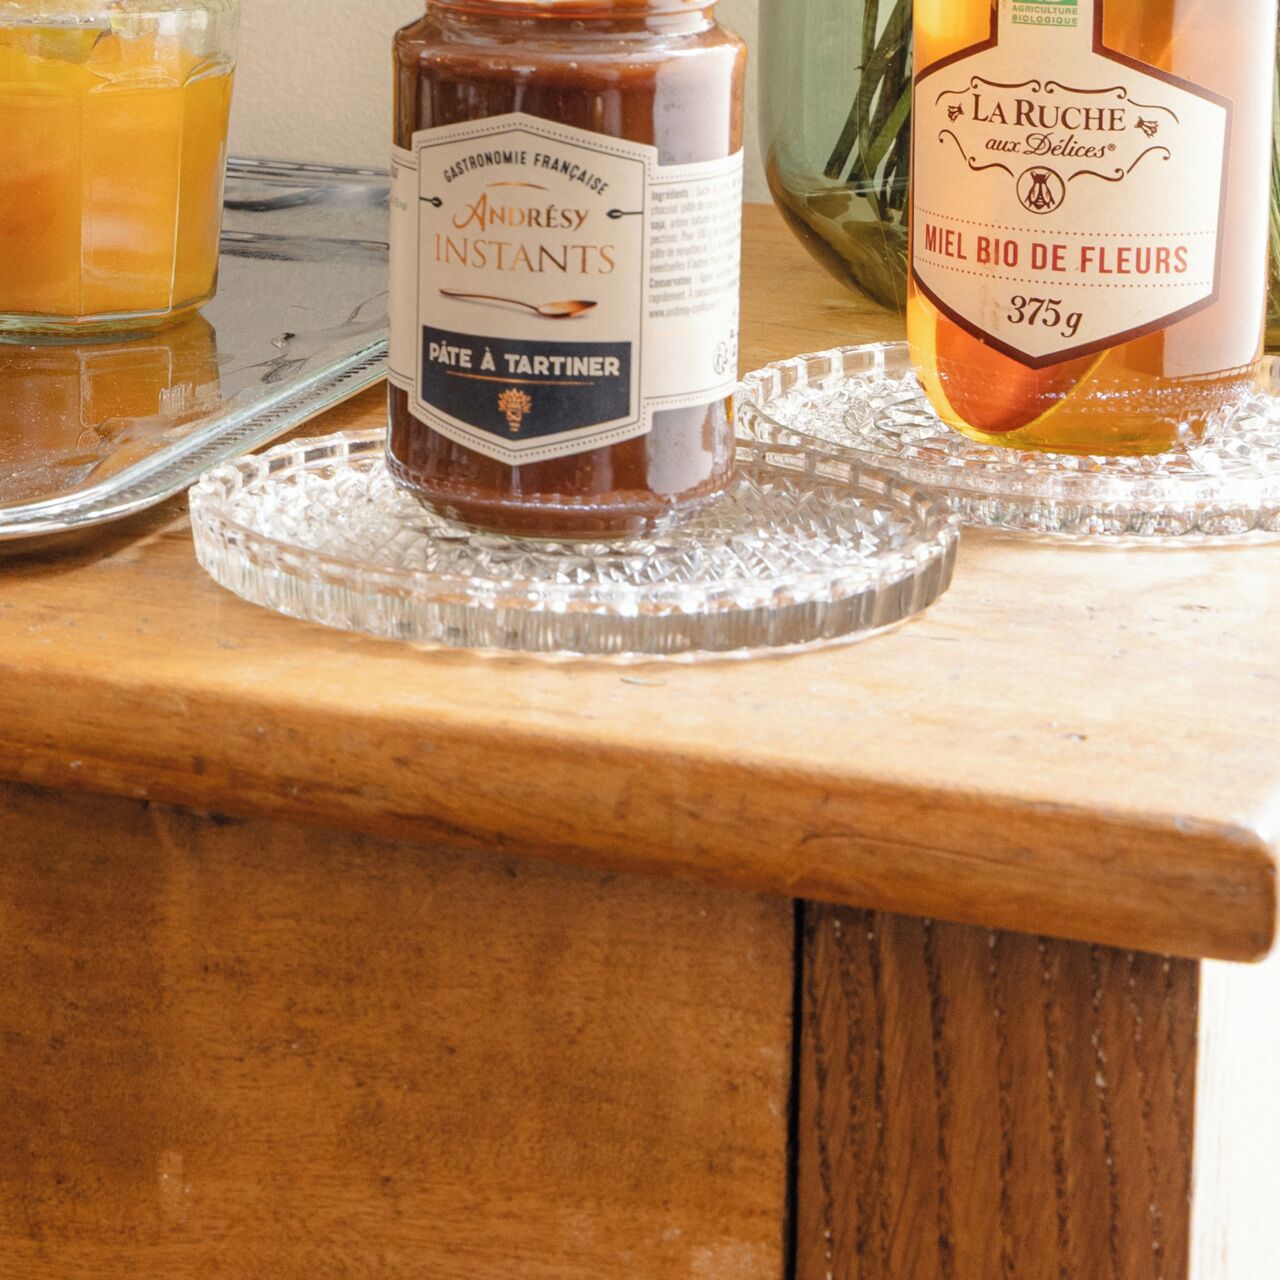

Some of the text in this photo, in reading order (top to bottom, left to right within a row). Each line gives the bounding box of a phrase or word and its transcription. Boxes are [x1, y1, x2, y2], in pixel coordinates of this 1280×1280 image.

[1011, 4, 1079, 16] AGRICULTURE
[1011, 14, 1078, 25] BIOLOGIQUE
[971, 93, 1127, 132] LA RUCHE
[985, 137, 1021, 153] aux
[443, 150, 610, 196] GASTRONOMIE FRANÇAISE
[434, 232, 616, 275] INSTANTS
[924, 223, 1189, 275] MIEL BIO DE FLEURS
[429, 340, 621, 377] PÂTE À TARTINER
